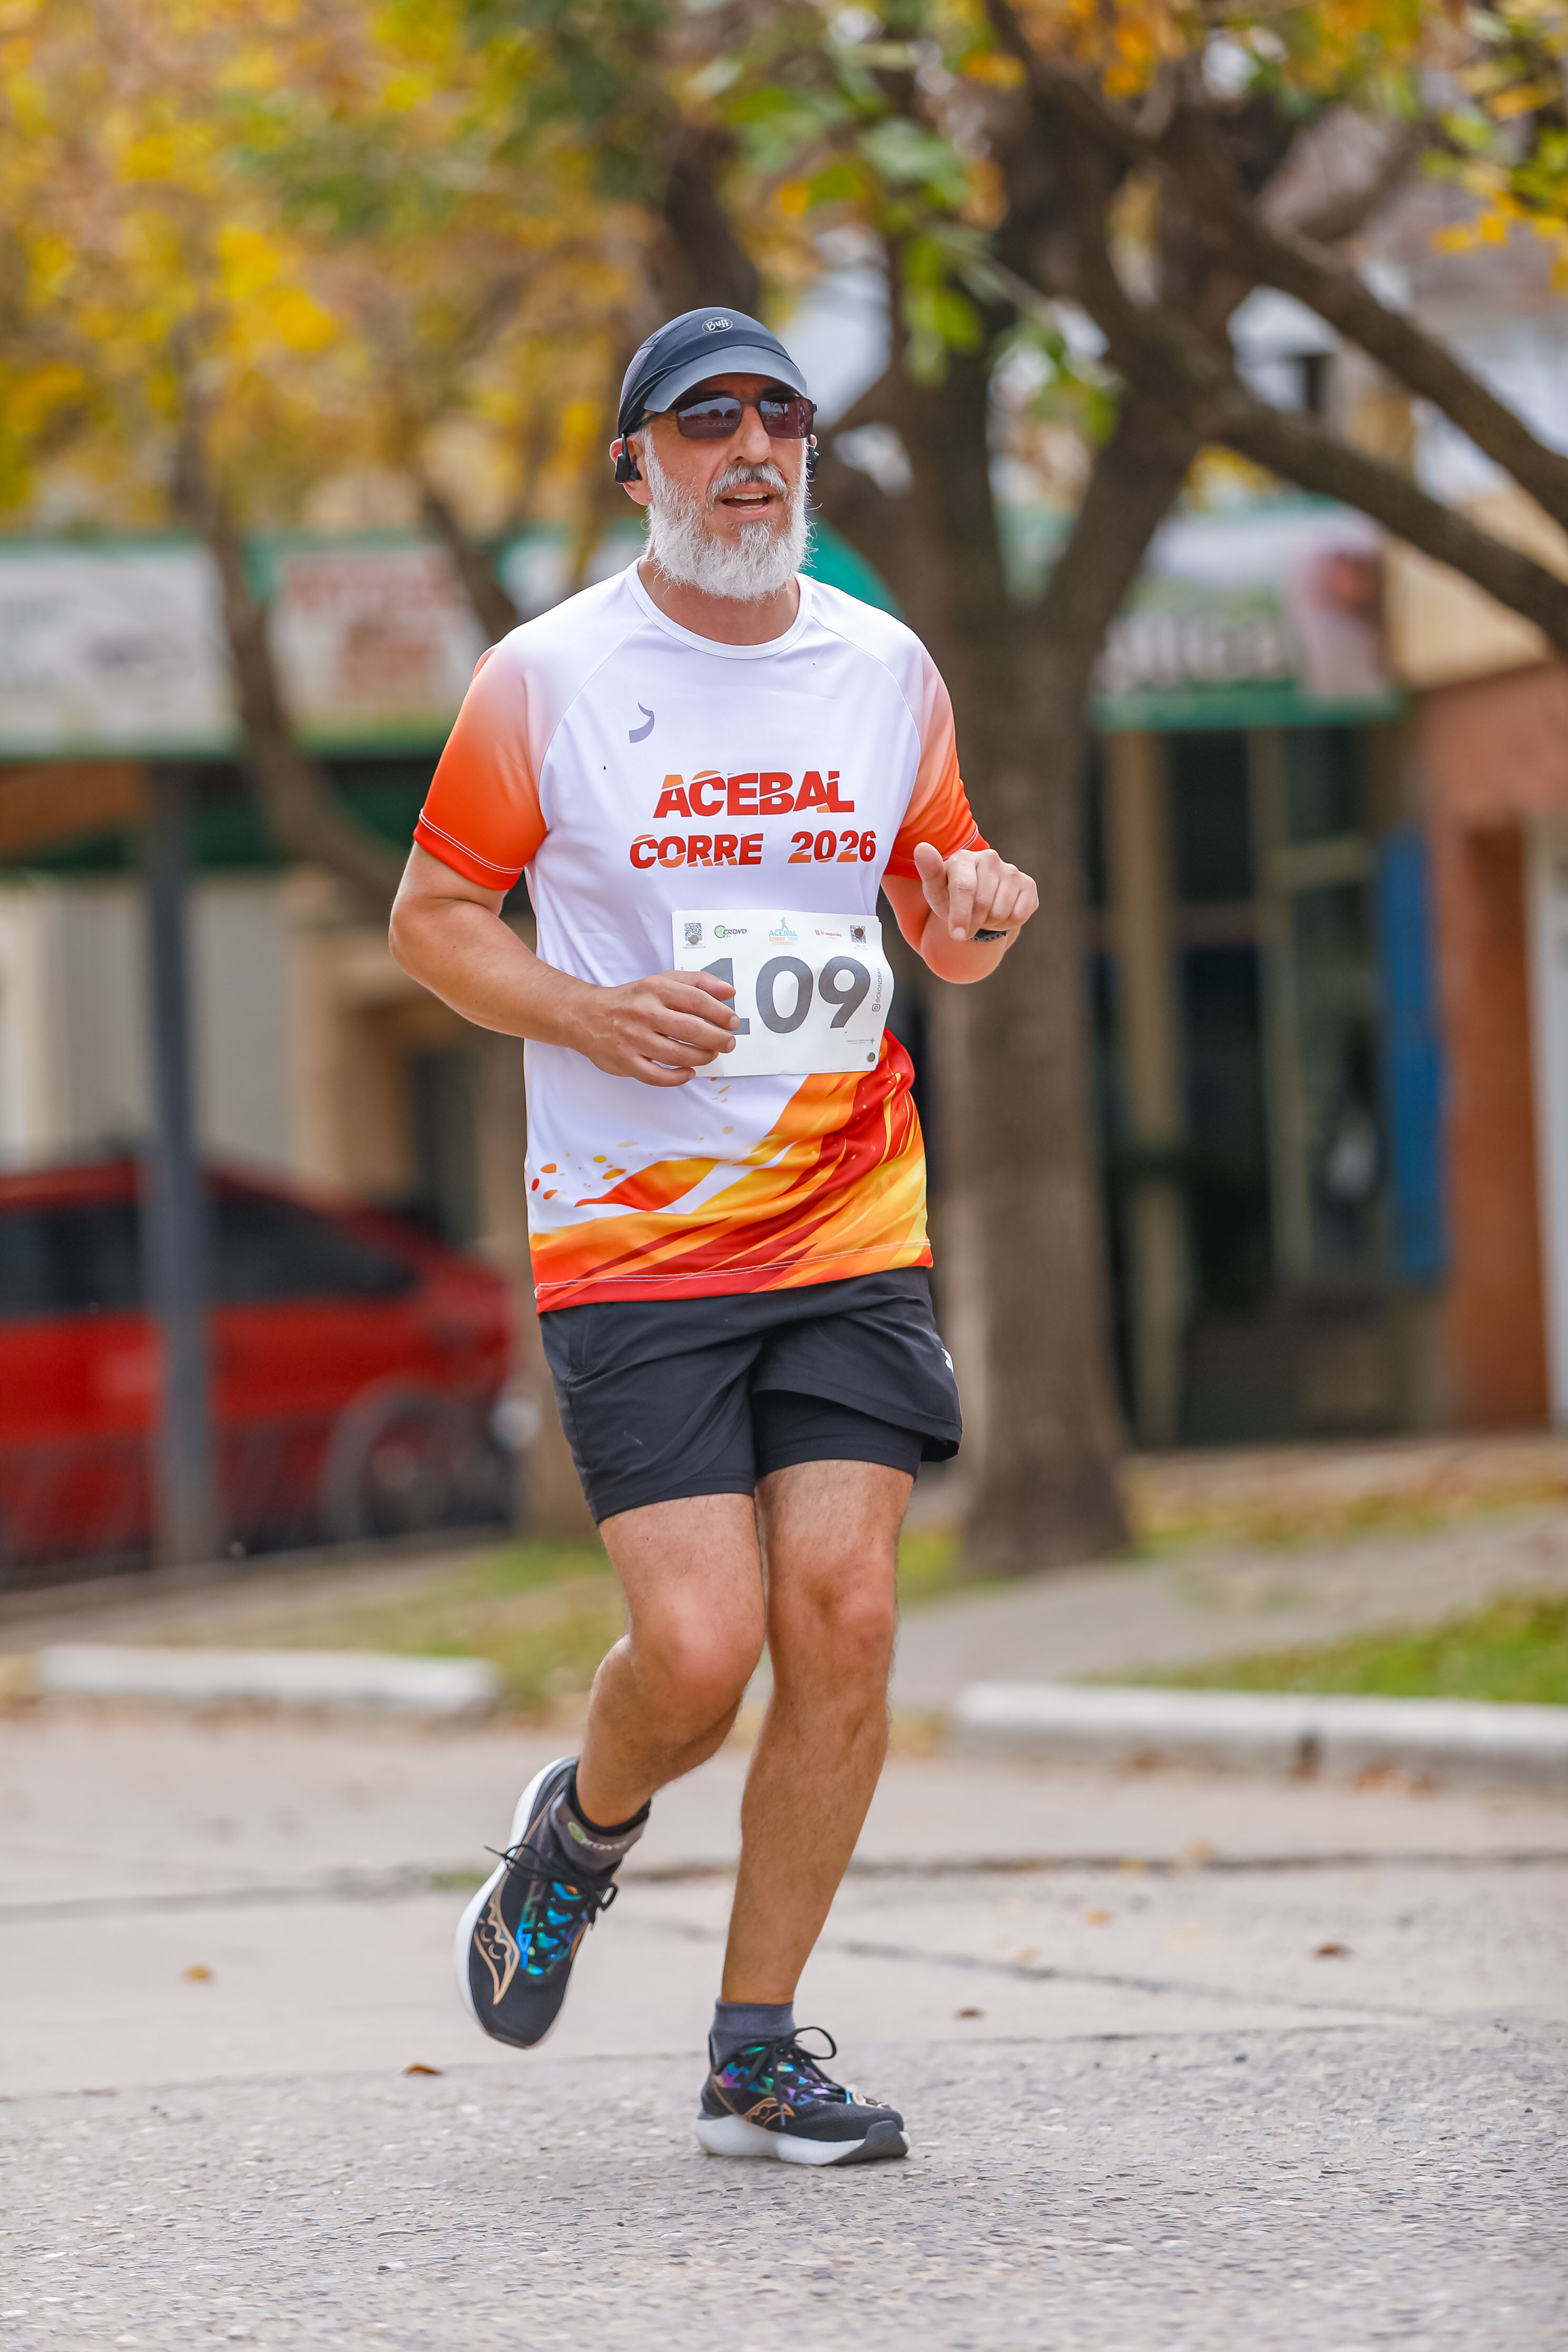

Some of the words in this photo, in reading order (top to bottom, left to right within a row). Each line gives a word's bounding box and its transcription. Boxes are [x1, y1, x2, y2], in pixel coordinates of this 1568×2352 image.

[653, 770, 855, 819] ACEBAL
[630, 833, 764, 869] CORRE
[788, 830, 876, 864] 2026
[700, 956, 871, 1035] 109
